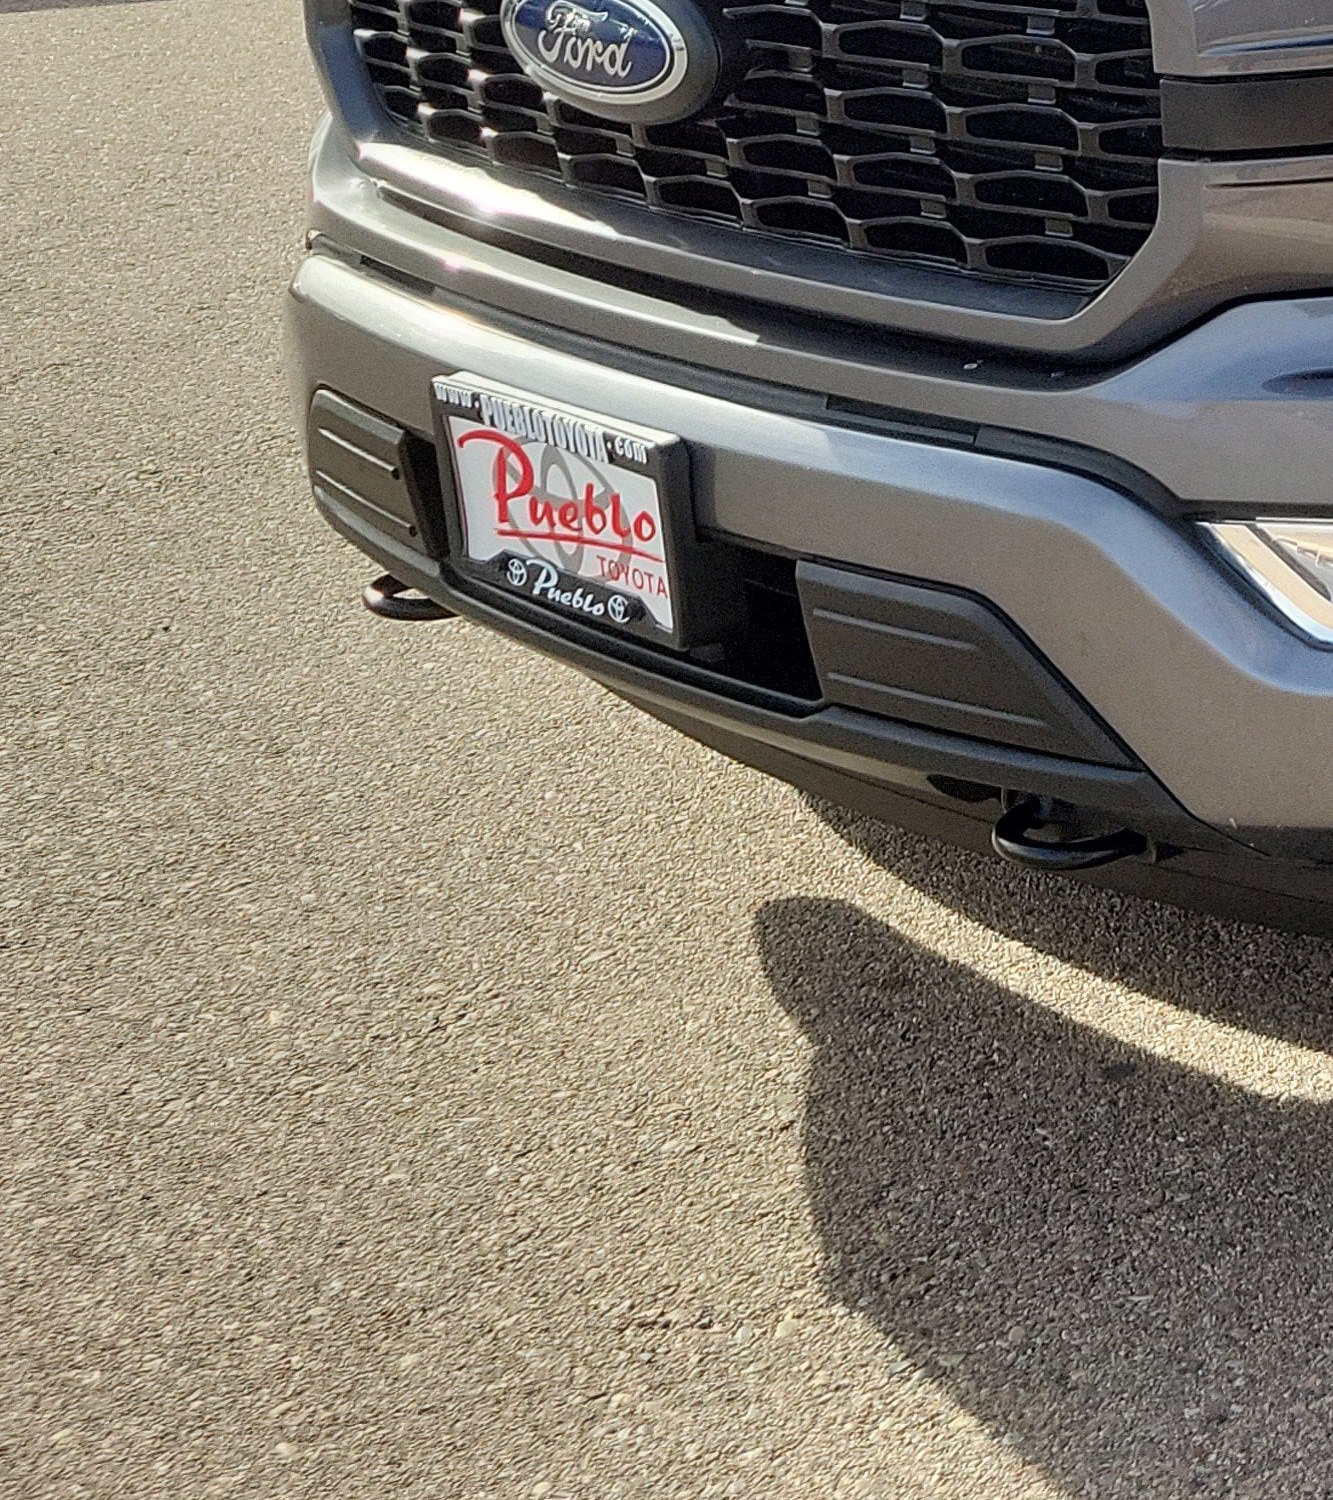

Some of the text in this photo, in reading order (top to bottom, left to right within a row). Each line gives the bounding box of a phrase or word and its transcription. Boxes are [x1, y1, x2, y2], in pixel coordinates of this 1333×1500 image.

[538, 0, 633, 78] Ford
[457, 429, 656, 542] Pueblo
[526, 558, 606, 616] Pueblo
[596, 555, 669, 599] TOYOTA
